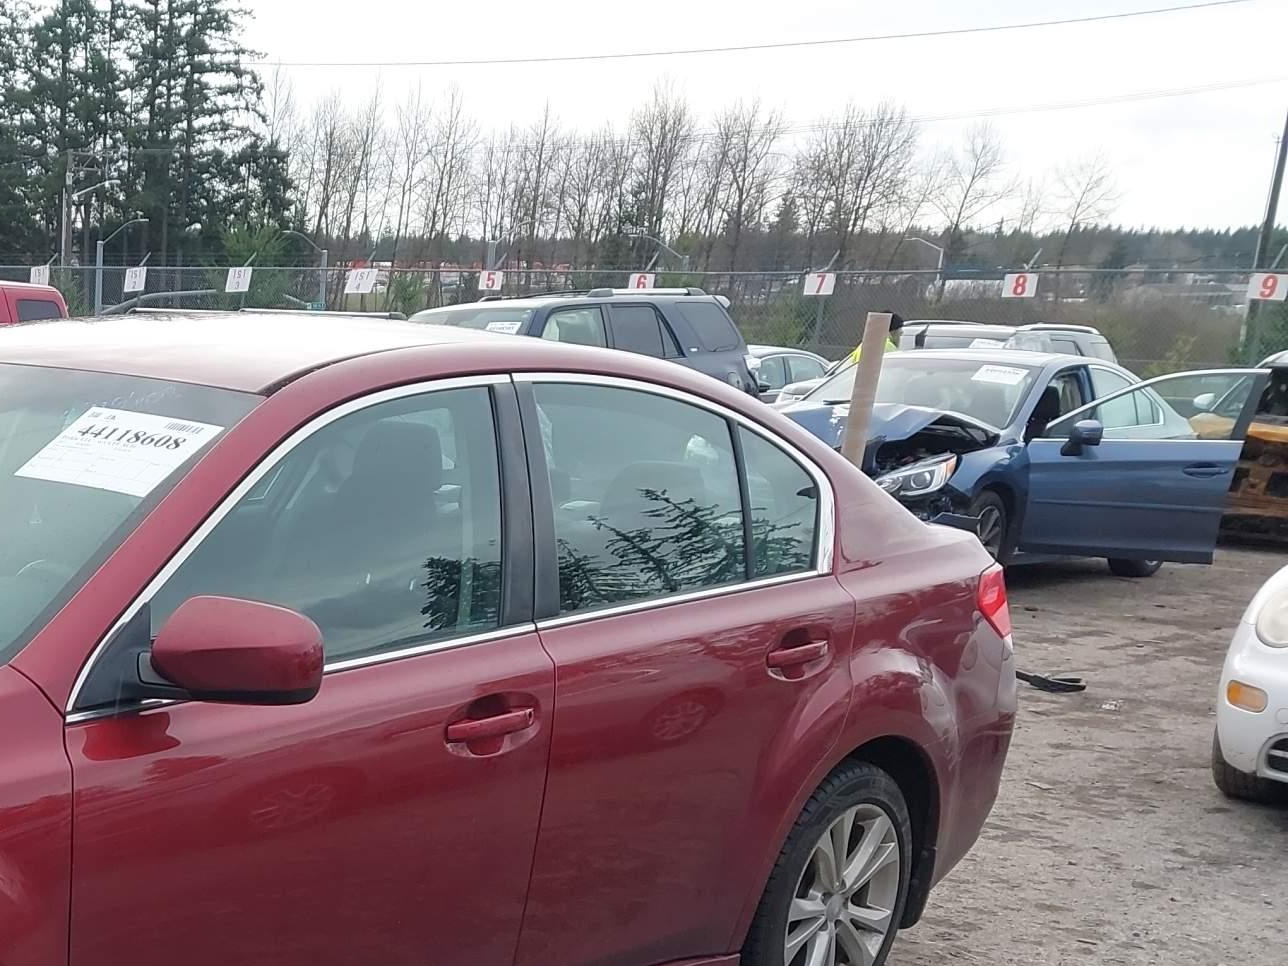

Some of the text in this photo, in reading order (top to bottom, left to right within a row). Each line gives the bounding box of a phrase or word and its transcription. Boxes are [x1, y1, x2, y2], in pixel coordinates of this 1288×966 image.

[486, 272, 496, 289] 5
[637, 275, 647, 288] 6
[815, 274, 826, 294] 7
[1013, 275, 1027, 295] 8
[1259, 274, 1279, 299] 9
[78, 424, 187, 450] 44118608
